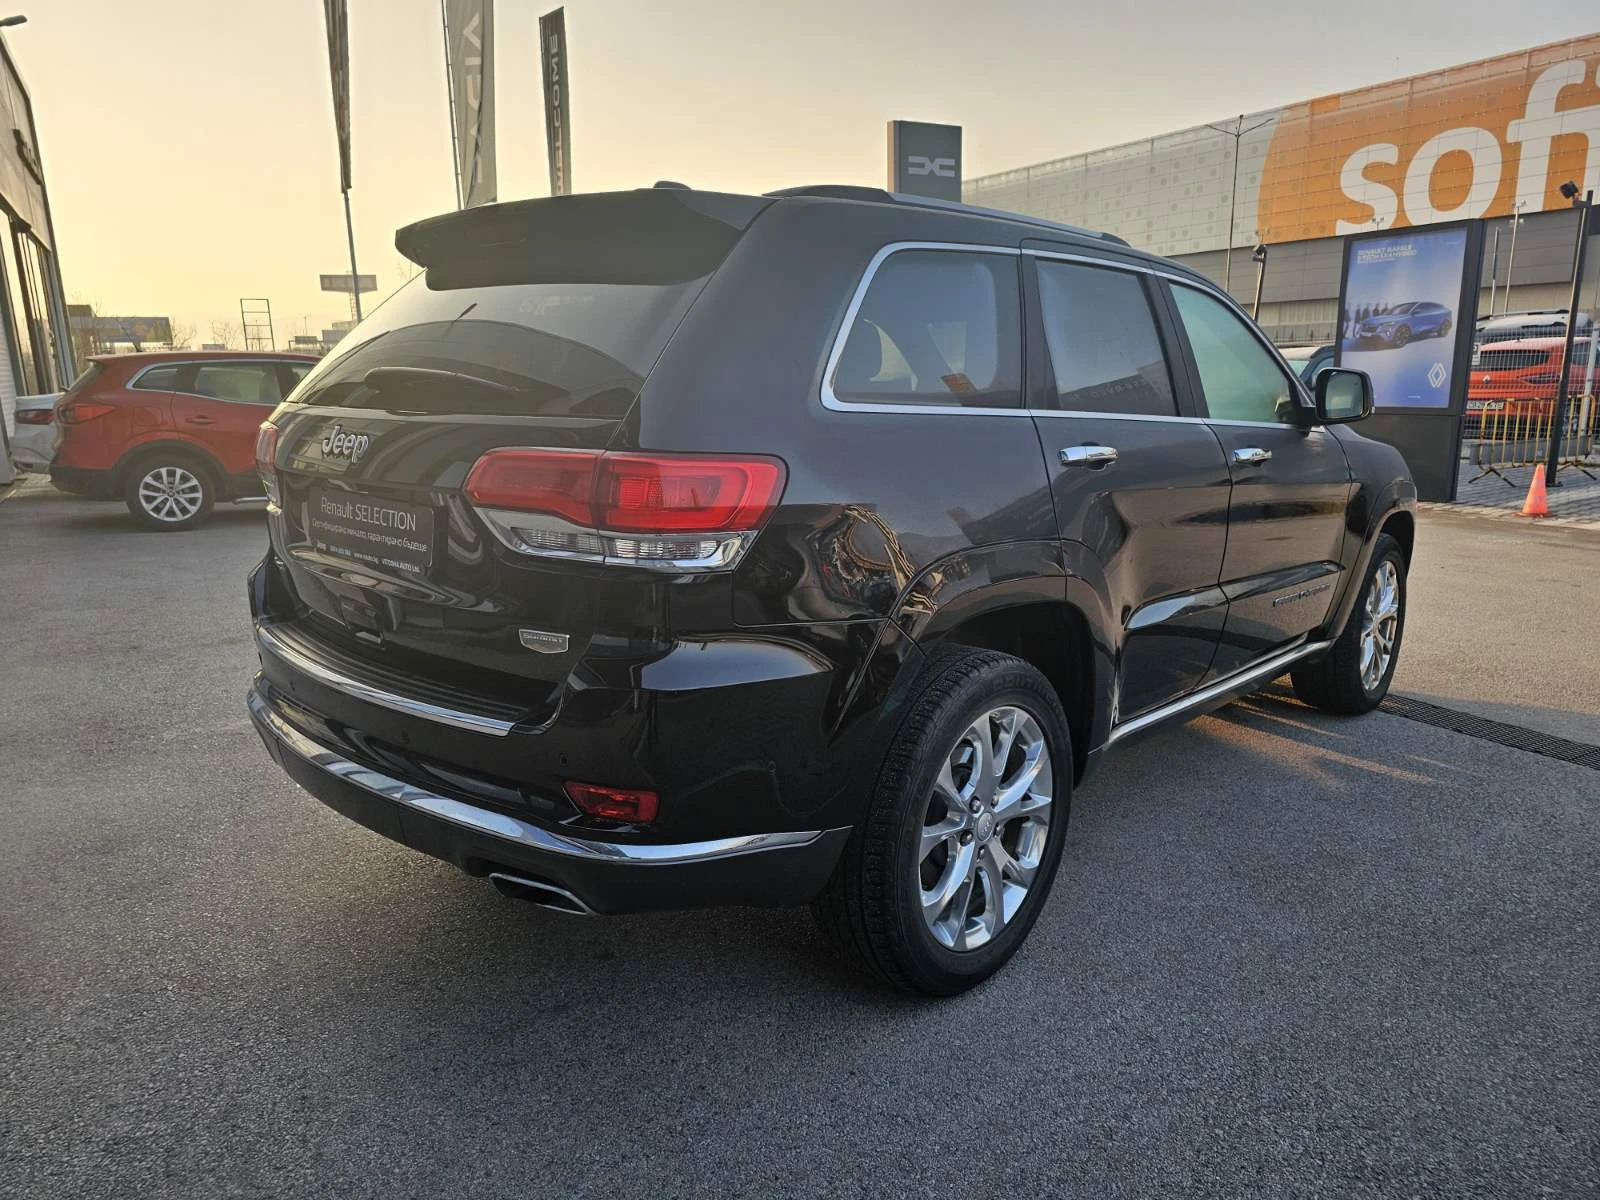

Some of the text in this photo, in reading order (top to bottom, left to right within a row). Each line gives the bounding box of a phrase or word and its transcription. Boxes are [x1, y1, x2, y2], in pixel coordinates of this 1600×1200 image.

[322, 425, 369, 463] Jeep
[321, 496, 416, 531] Renault SELECTION
